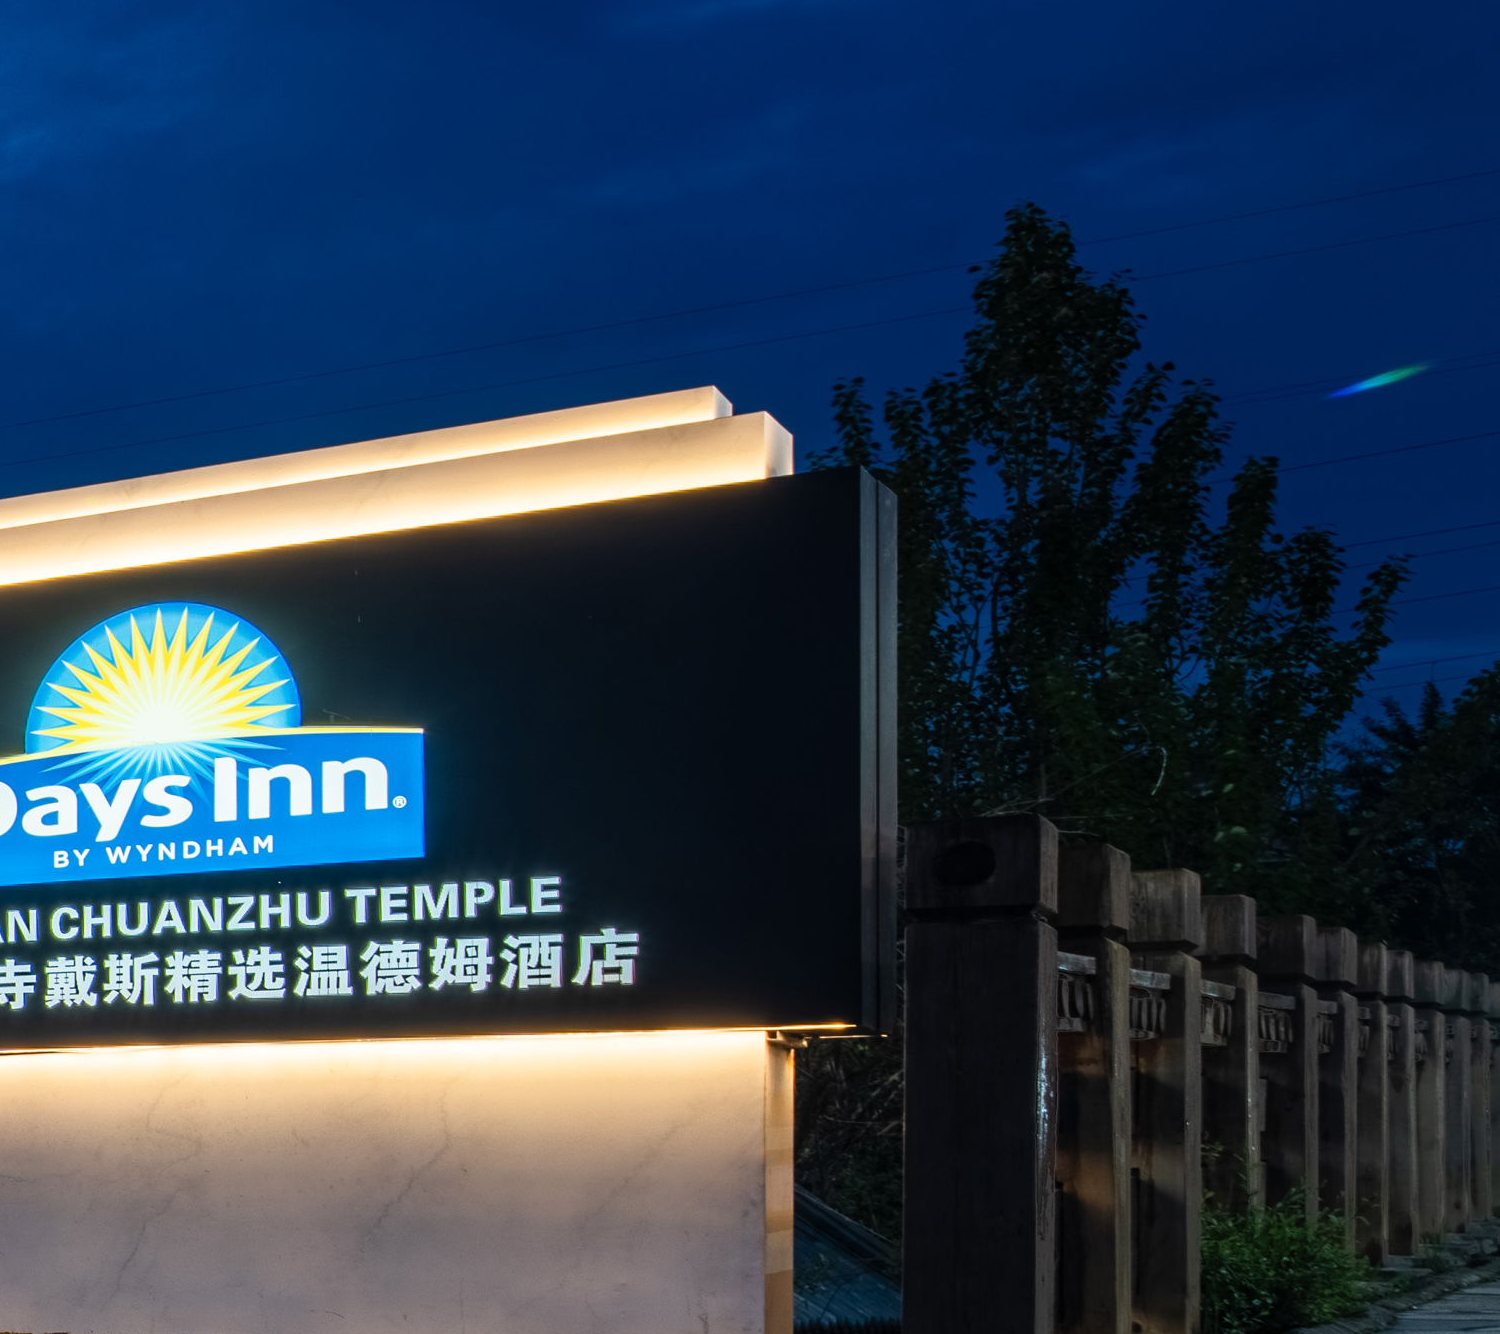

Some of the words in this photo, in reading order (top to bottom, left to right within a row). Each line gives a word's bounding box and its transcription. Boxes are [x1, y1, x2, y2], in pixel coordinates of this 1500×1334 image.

[53, 848, 90, 868] BY
[106, 835, 275, 865] WYNDHAM
[50, 889, 331, 939] CHUANZHU
[345, 876, 562, 924] TEMPLE
